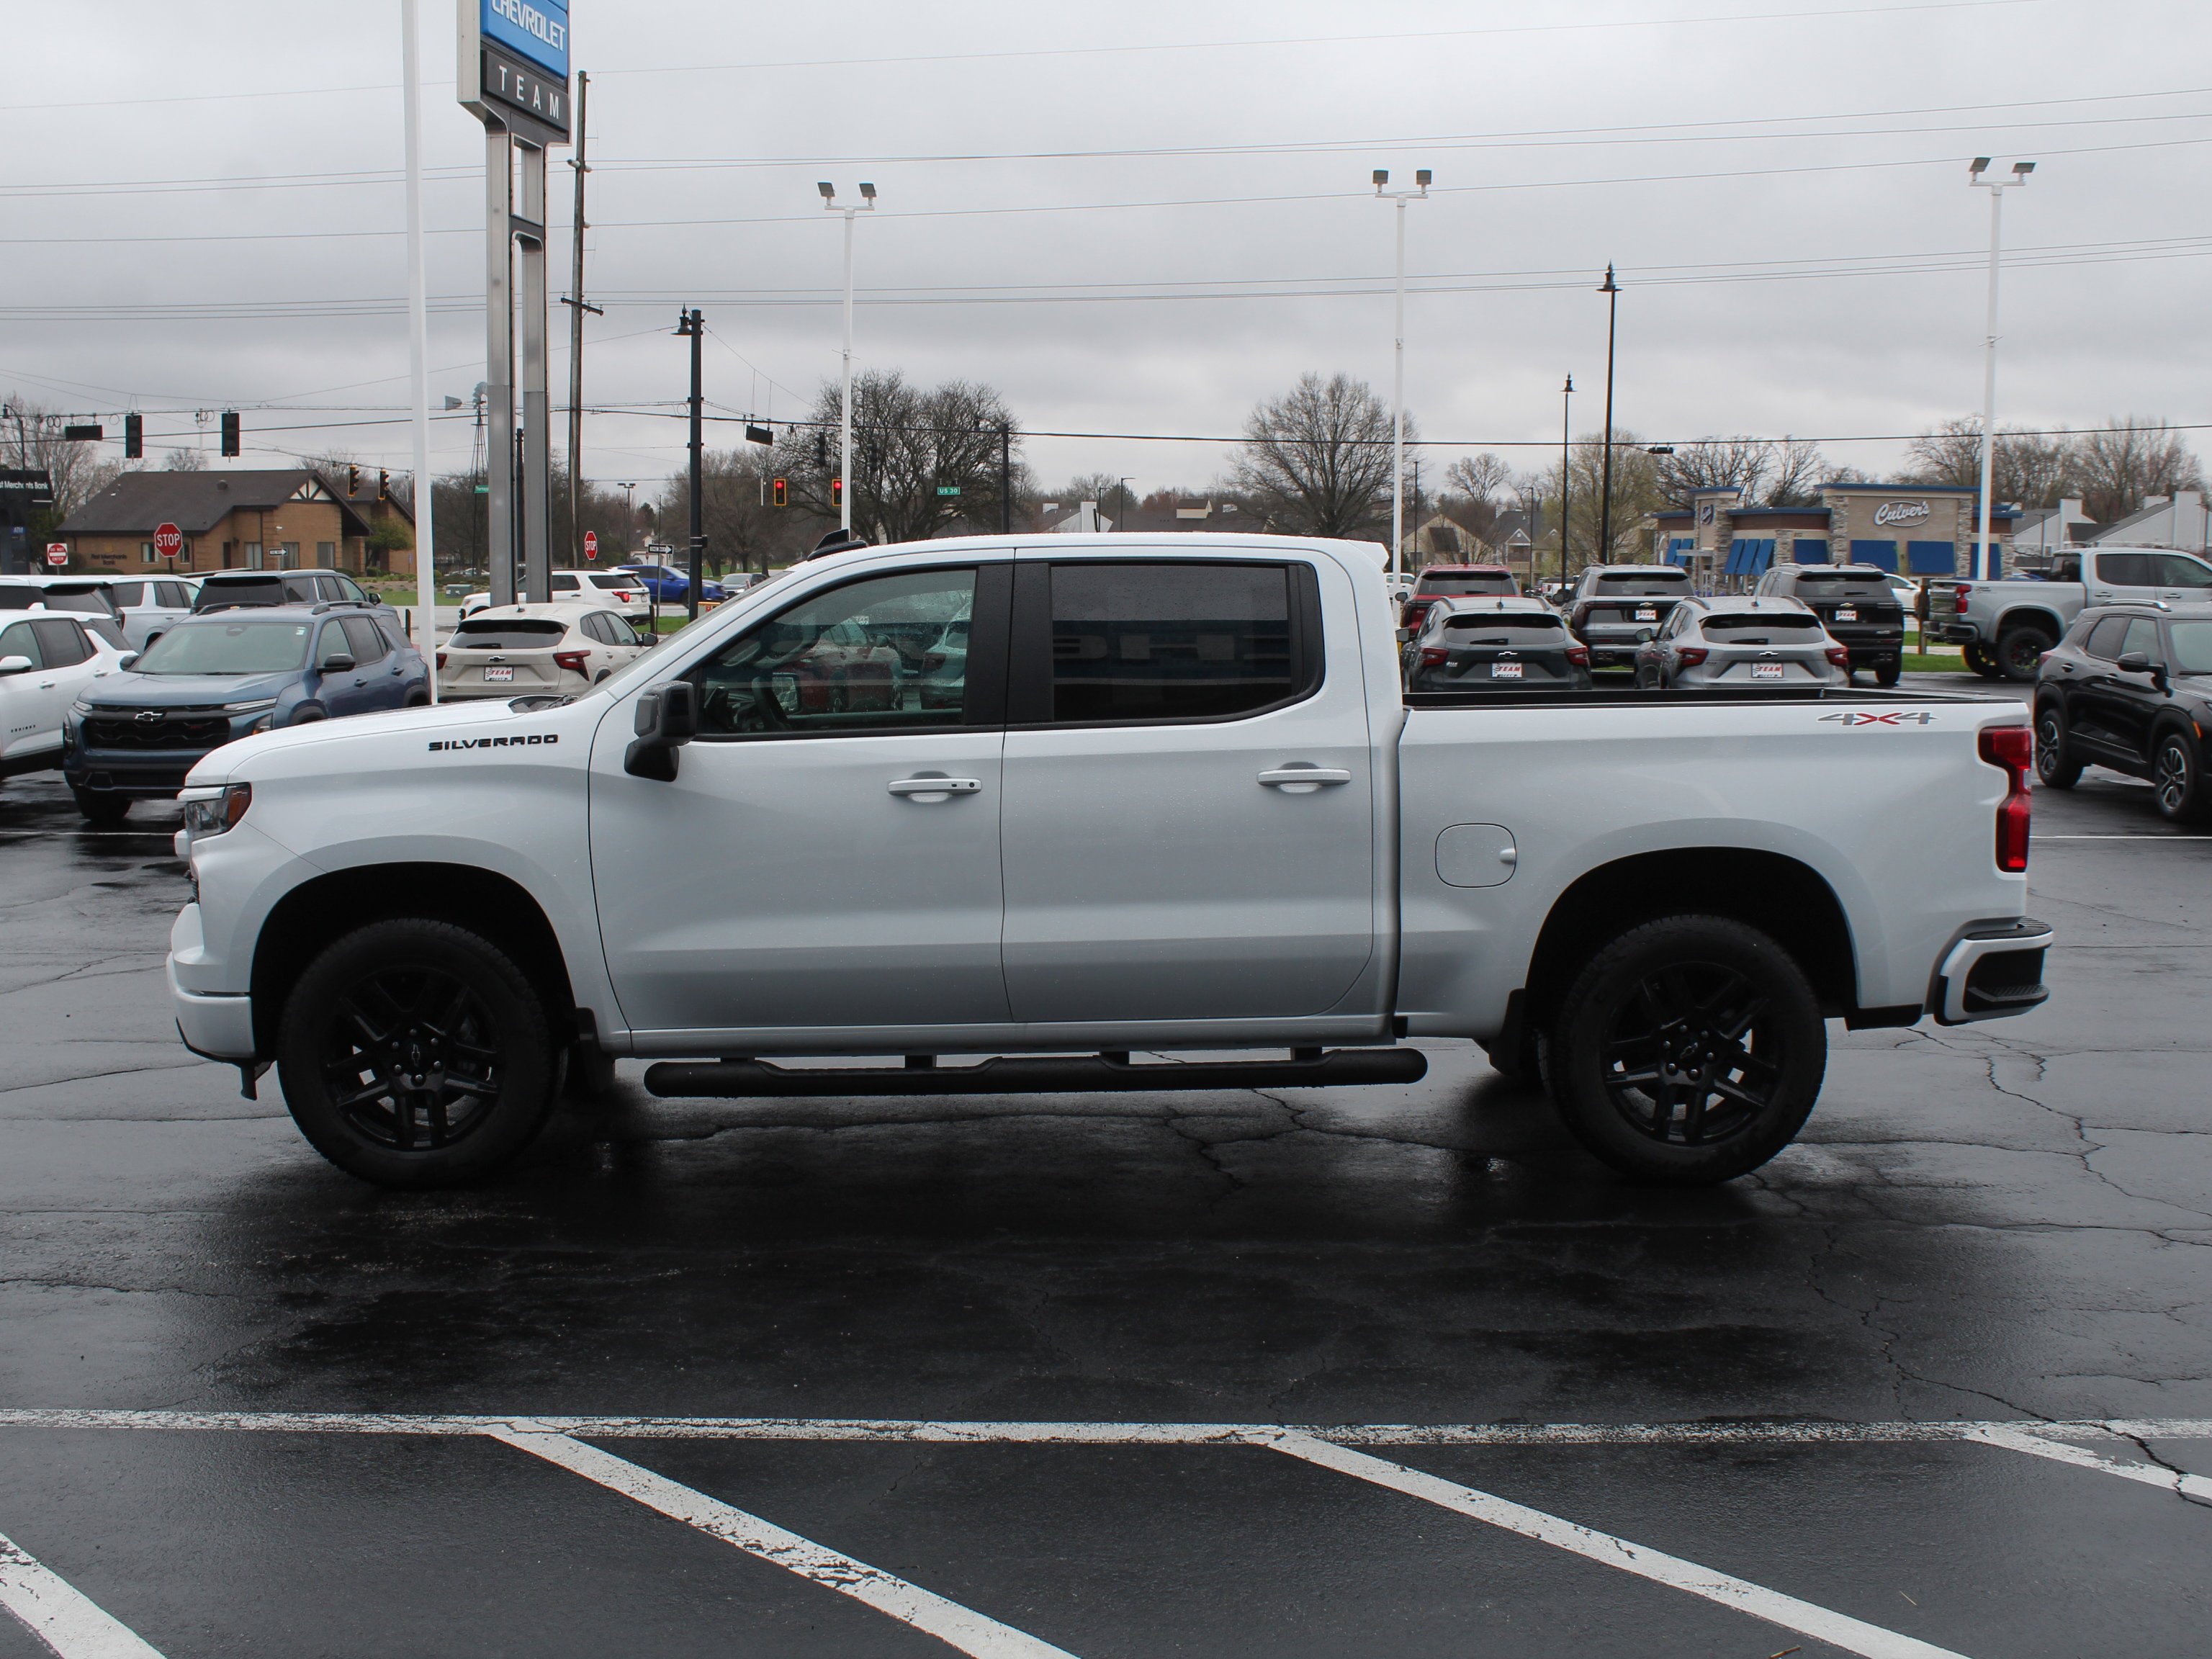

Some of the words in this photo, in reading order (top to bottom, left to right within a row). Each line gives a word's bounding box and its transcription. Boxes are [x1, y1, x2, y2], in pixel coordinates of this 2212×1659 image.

[499, 65, 559, 120] TEAM
[1874, 501, 1930, 525] Culver's
[156, 534, 180, 547] STOP
[585, 540, 596, 551] STOP
[428, 734, 559, 751] SILVERADO
